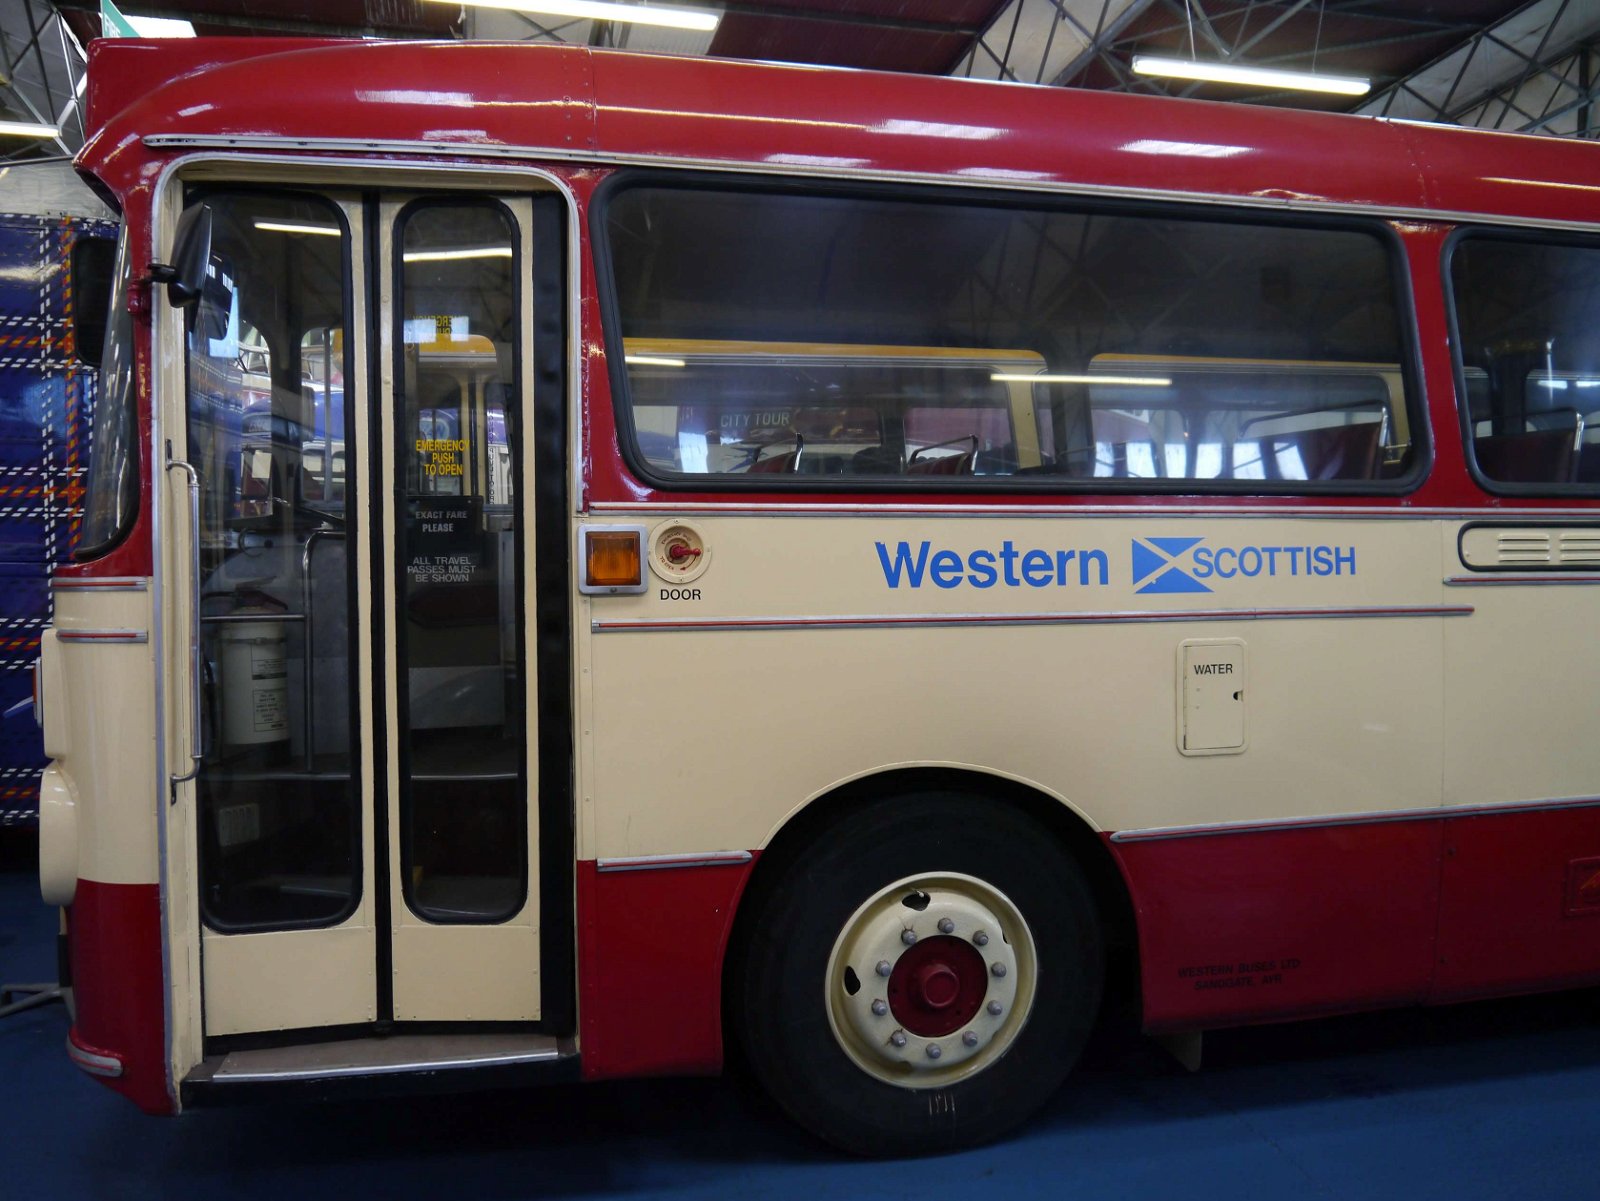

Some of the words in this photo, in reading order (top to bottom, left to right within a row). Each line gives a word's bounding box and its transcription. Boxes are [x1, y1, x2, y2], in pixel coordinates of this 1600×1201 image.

[720, 414, 751, 427] CITY
[756, 411, 791, 426] TOUR
[415, 439, 470, 451] EMERGENCY
[432, 452, 455, 463] PUSH
[424, 464, 437, 476] TO
[438, 464, 463, 475] OPEN
[415, 510, 443, 519] EXACT
[446, 510, 468, 519] FARE
[422, 523, 454, 533] PLEASE
[412, 556, 431, 565] ALL
[434, 556, 471, 565] TRAVEL
[874, 541, 1109, 588] Western
[1192, 546, 1356, 578] SCOTTISH
[407, 565, 445, 574] PASSES
[448, 565, 476, 573] MUST
[415, 574, 429, 583] BE
[431, 573, 469, 582] SHOWN
[660, 588, 701, 600] DOOR
[1193, 663, 1233, 675] WATER
[1178, 965, 1232, 977] WESTERN
[1238, 960, 1275, 973] BUSES
[1280, 959, 1300, 970] LTD
[1262, 974, 1282, 985] AYR
